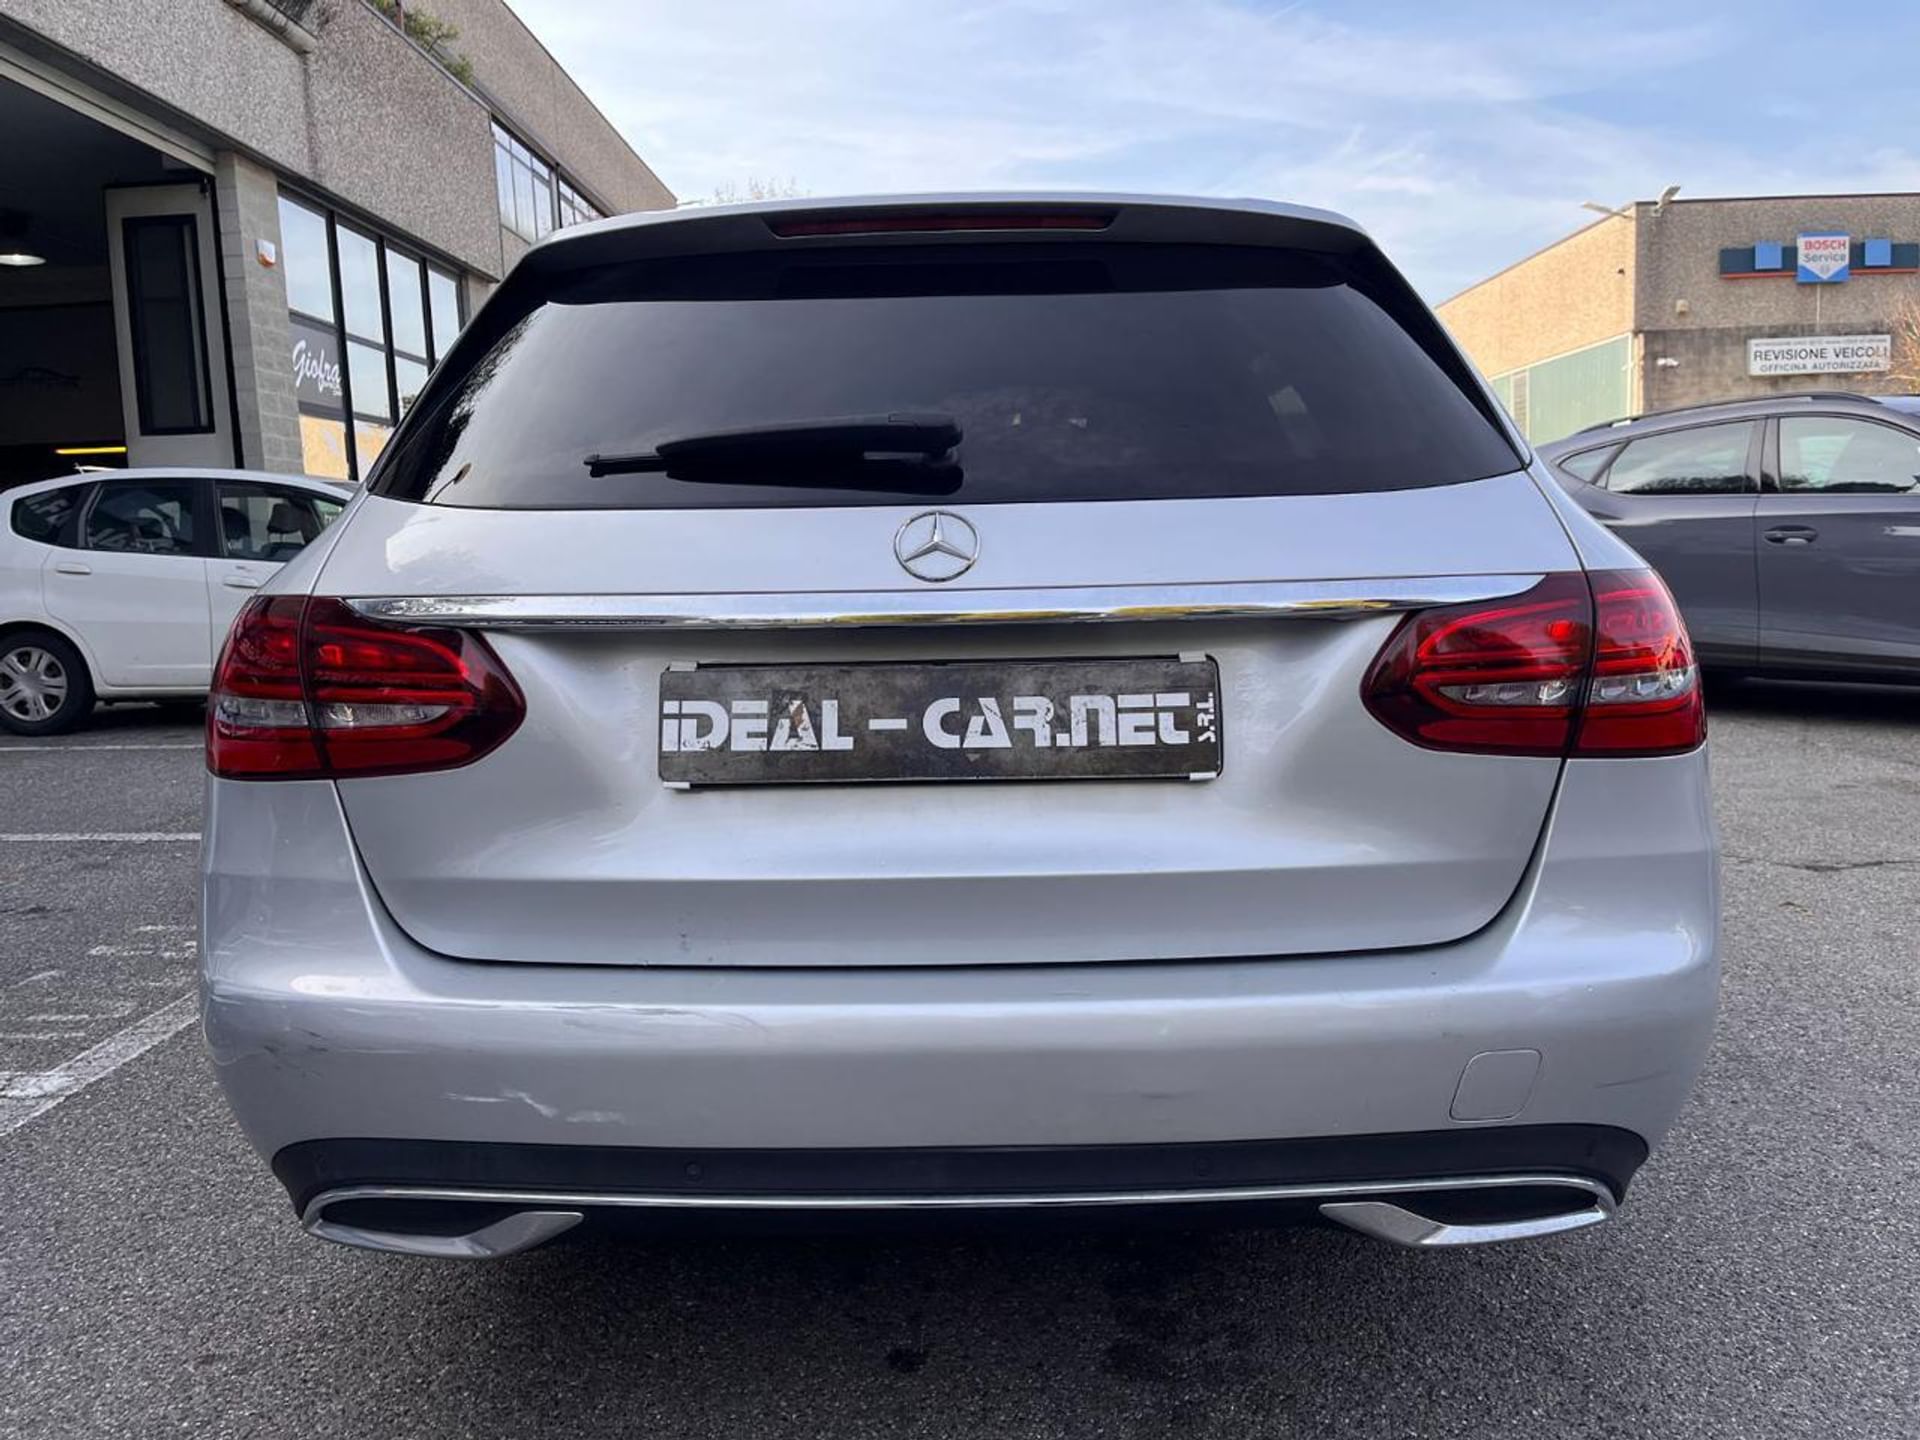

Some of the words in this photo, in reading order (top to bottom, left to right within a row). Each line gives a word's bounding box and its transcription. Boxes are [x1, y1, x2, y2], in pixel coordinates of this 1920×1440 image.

[1804, 239, 1847, 250] BOSCH
[1803, 252, 1847, 263] Service
[1753, 348, 1828, 361] REVISIONE
[1833, 345, 1887, 359] VEICOLI
[1760, 362, 1808, 372] OFFICINA
